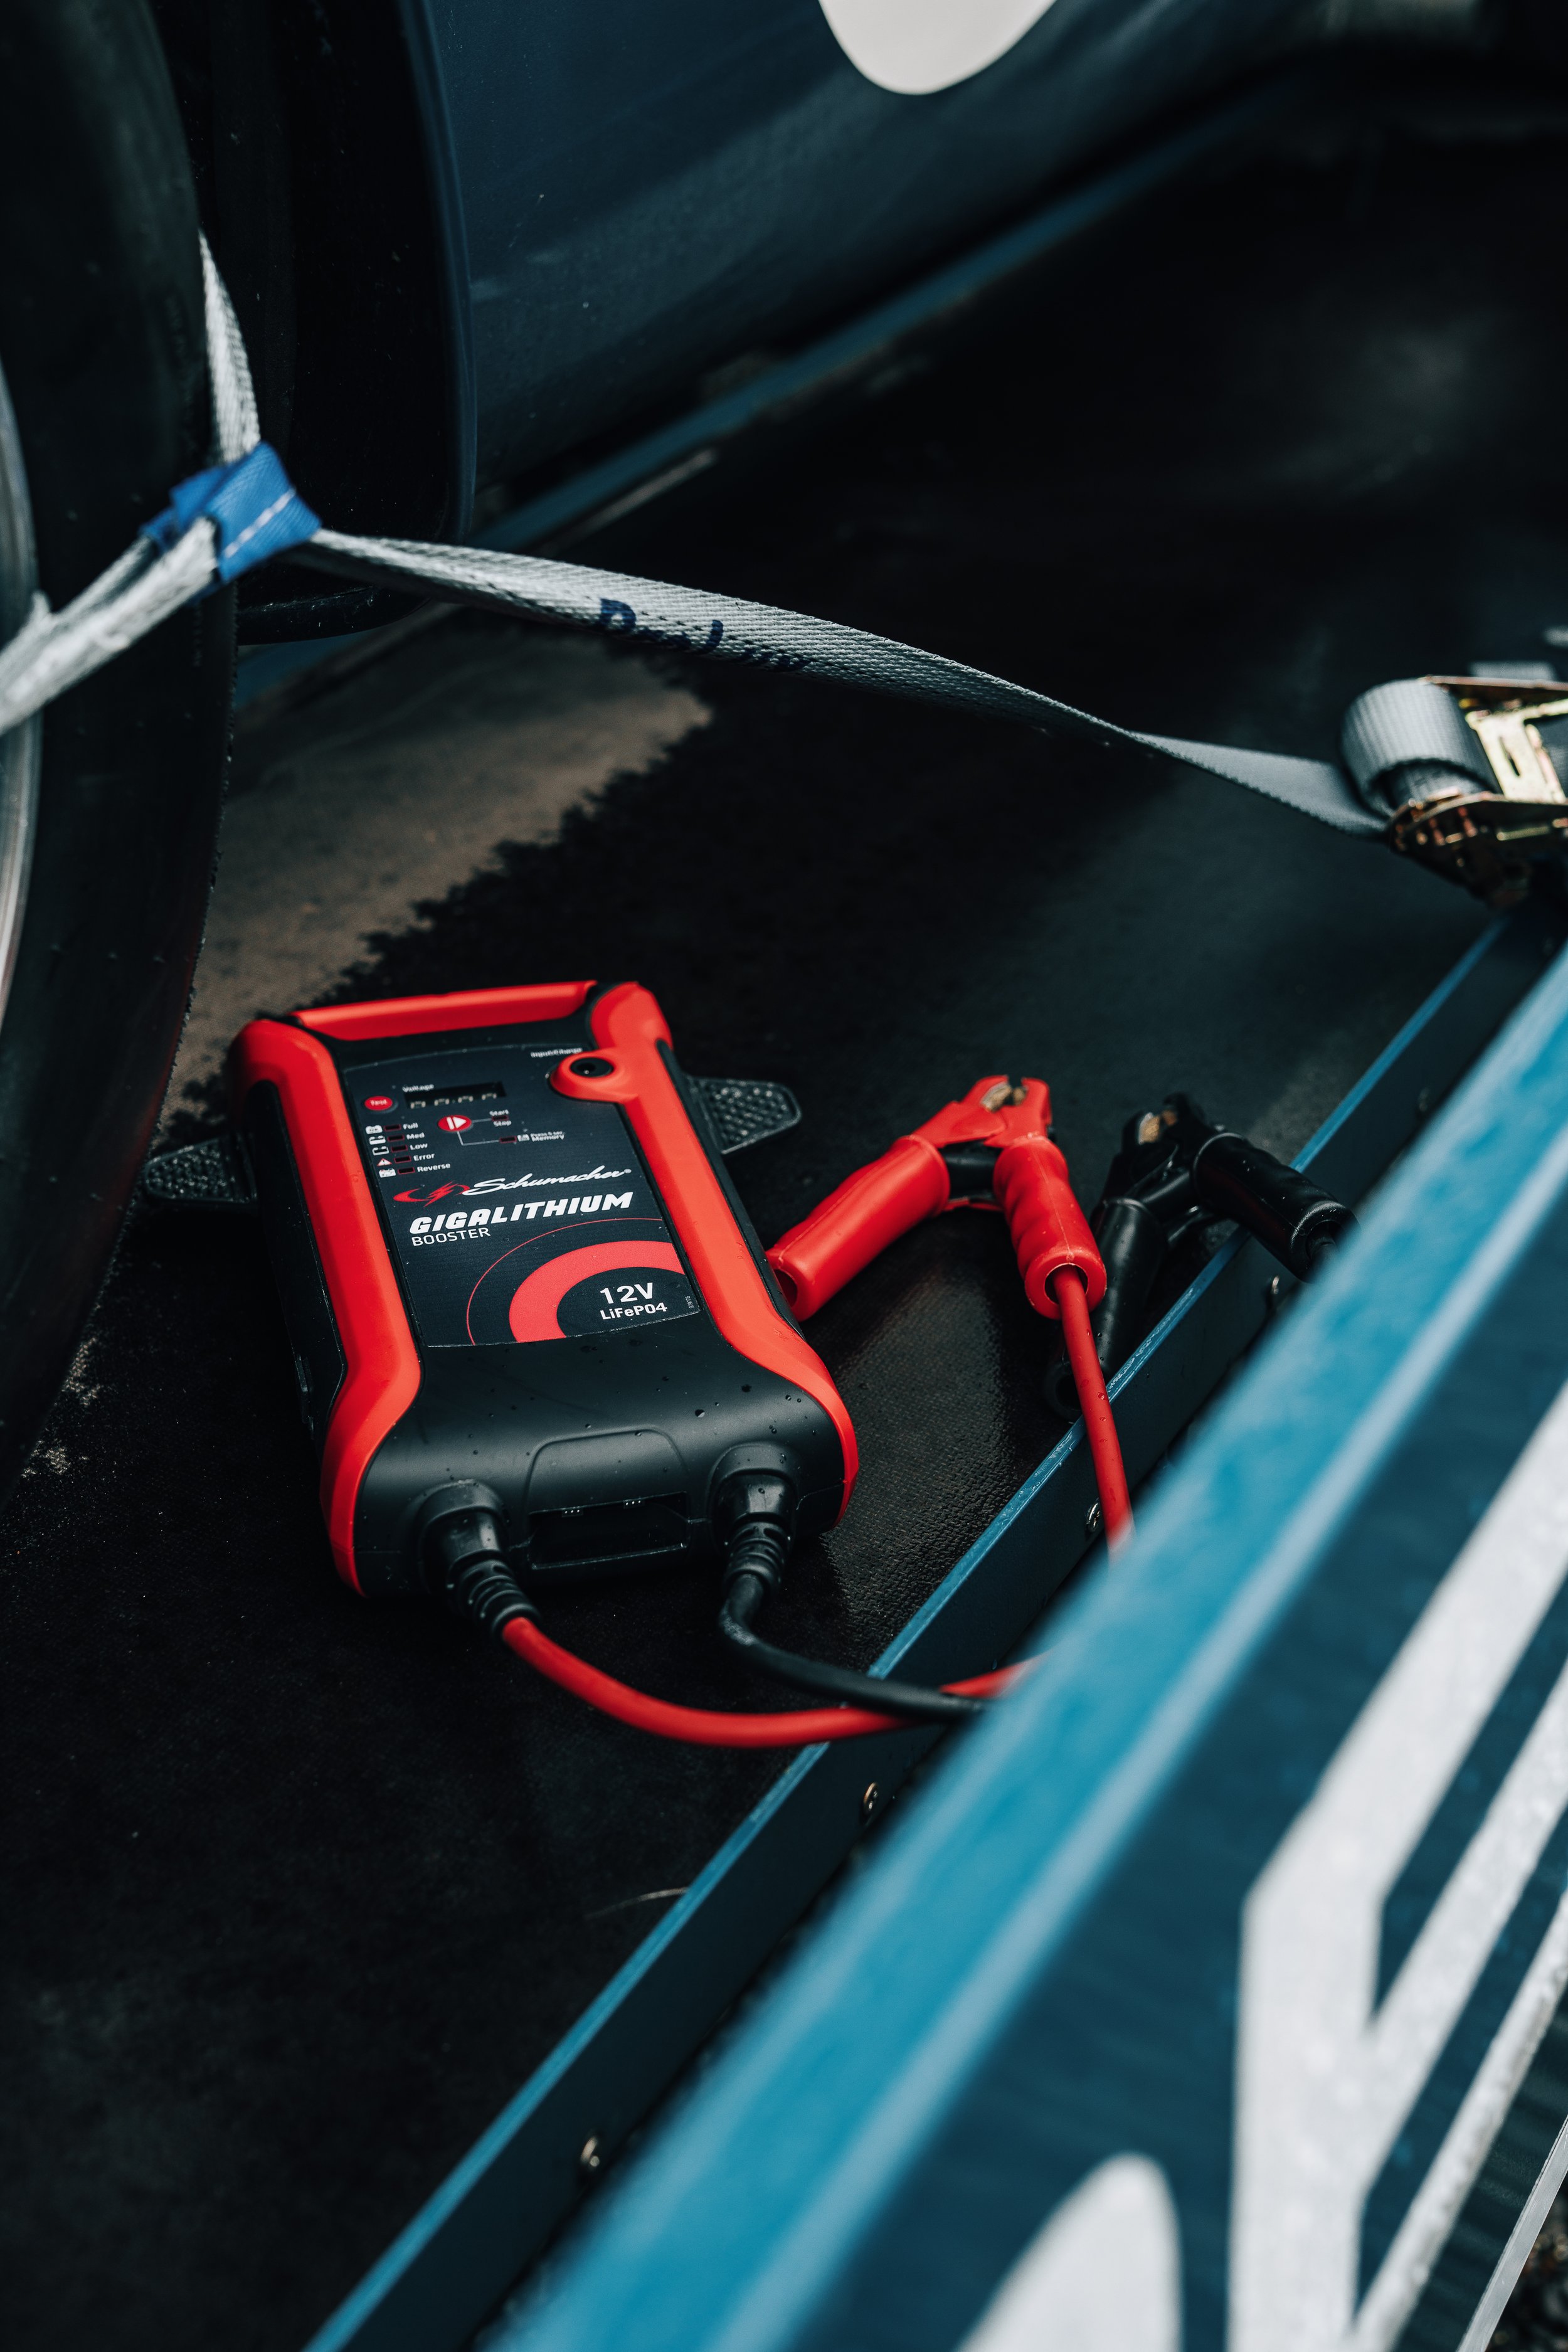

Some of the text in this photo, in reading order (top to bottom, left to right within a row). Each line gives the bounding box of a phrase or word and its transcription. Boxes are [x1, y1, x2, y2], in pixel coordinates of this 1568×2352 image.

[531, 1134, 564, 1142] Memory
[413, 1153, 435, 1162] Error
[417, 1163, 450, 1172] Reverse
[409, 1192, 633, 1235] GIGALITHIUM
[411, 1227, 491, 1247] BOOSTER
[600, 1282, 654, 1305] 12V
